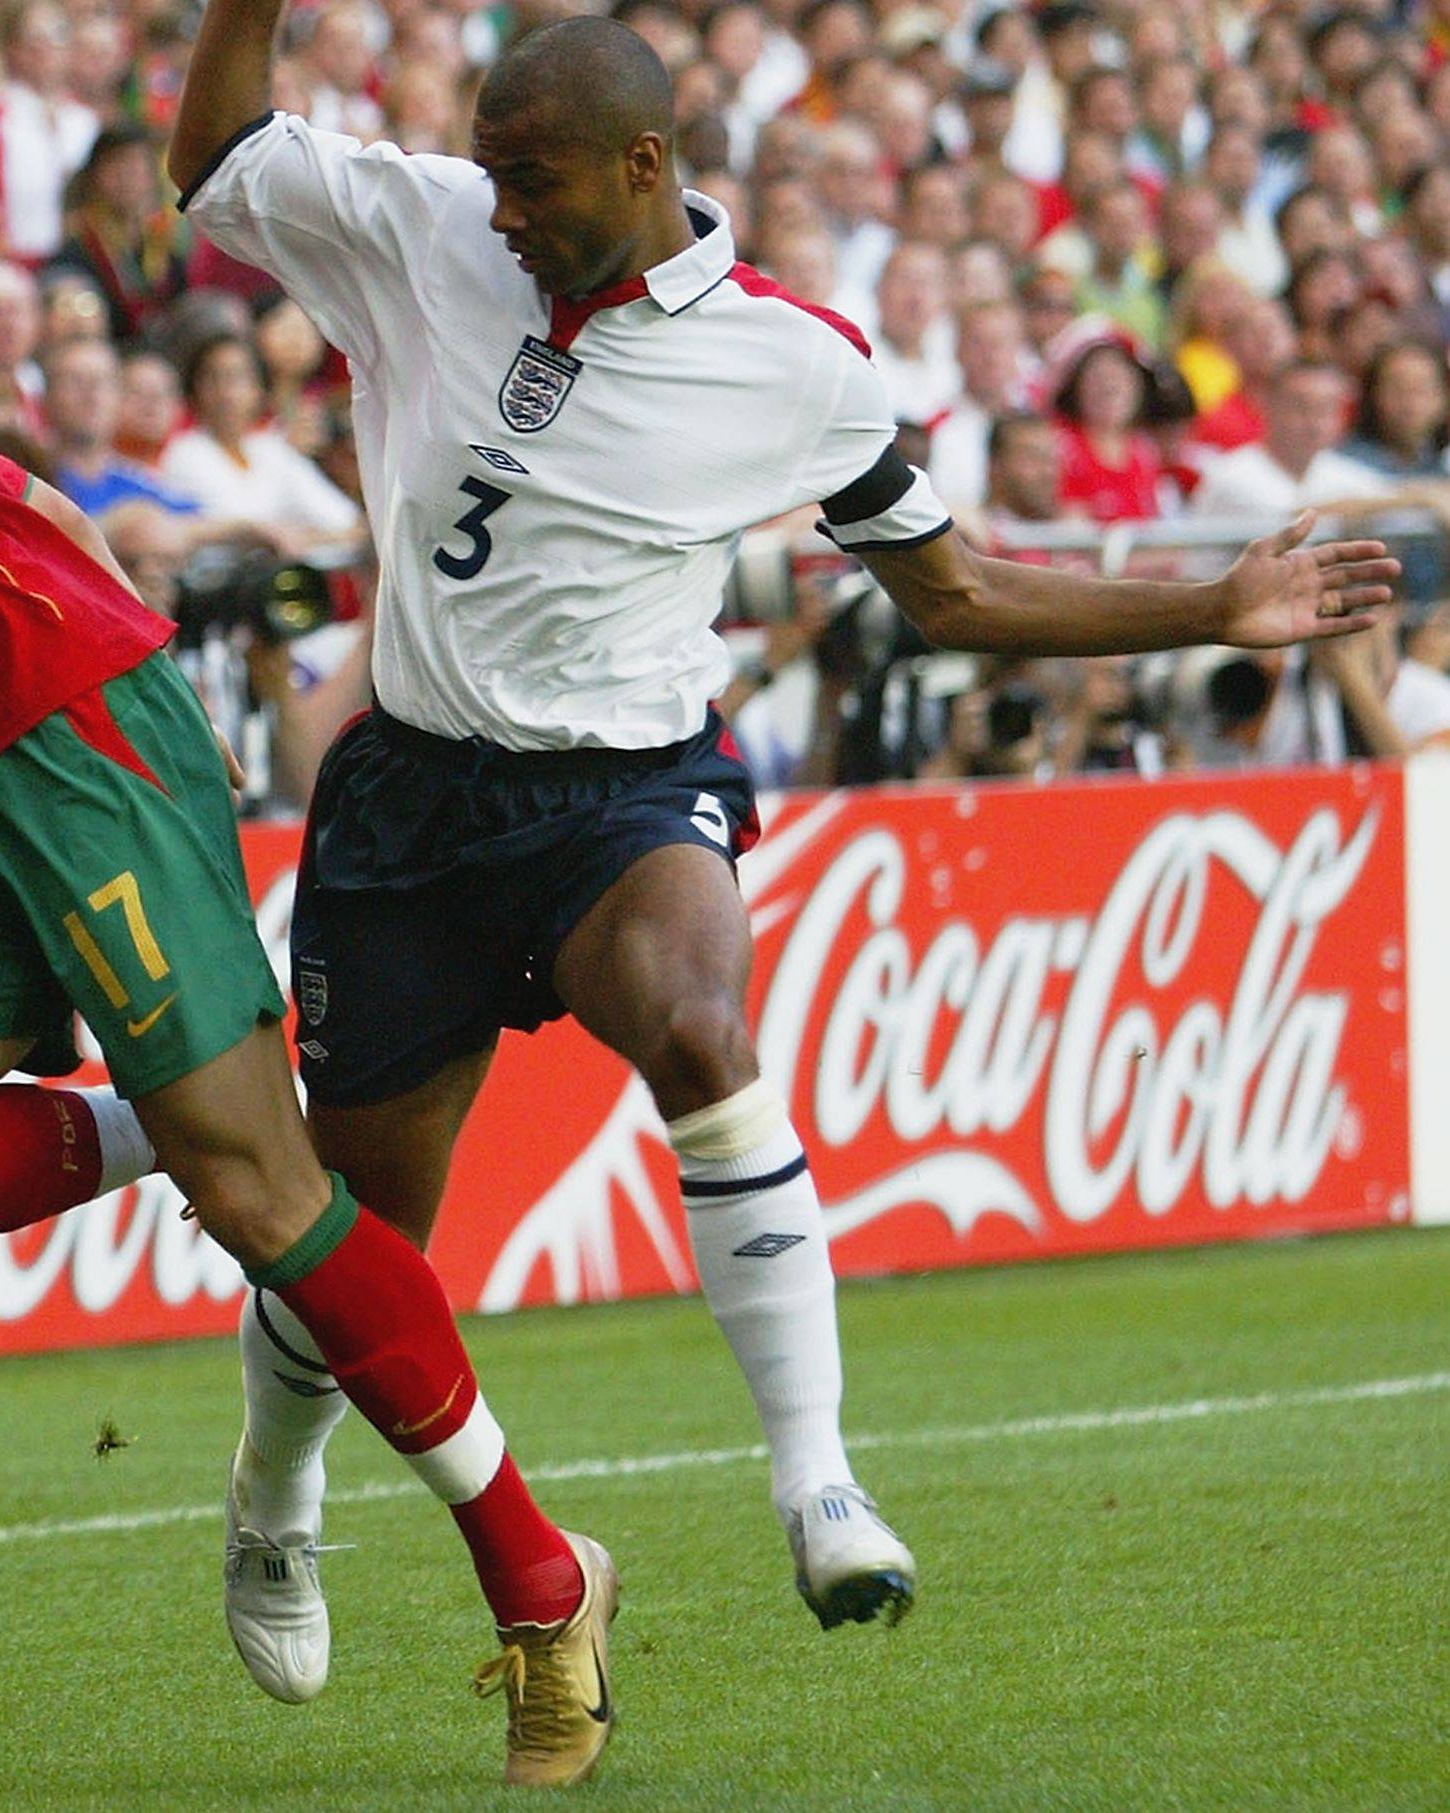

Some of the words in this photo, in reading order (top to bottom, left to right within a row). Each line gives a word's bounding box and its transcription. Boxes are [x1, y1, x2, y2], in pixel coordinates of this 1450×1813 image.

[432, 476, 513, 580] 3
[63, 870, 170, 1010] 17
[752, 798, 1382, 1237] Coca-Cola
